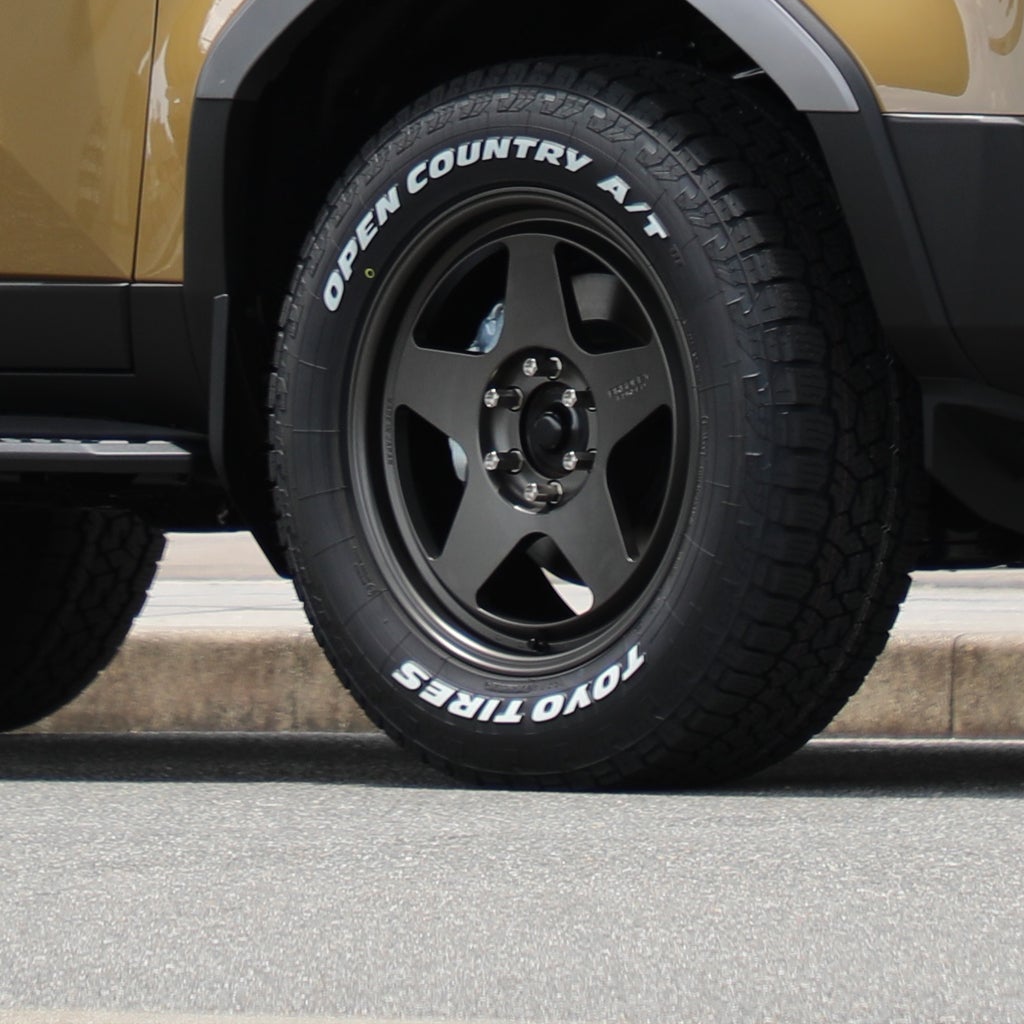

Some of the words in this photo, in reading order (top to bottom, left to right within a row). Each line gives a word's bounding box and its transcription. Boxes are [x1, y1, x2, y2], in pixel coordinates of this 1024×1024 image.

[323, 184, 401, 312] OPEN
[406, 136, 592, 194] COUNTRY
[597, 175, 669, 239] A/T
[391, 660, 527, 723] TIRES
[531, 643, 646, 722] TOYO
